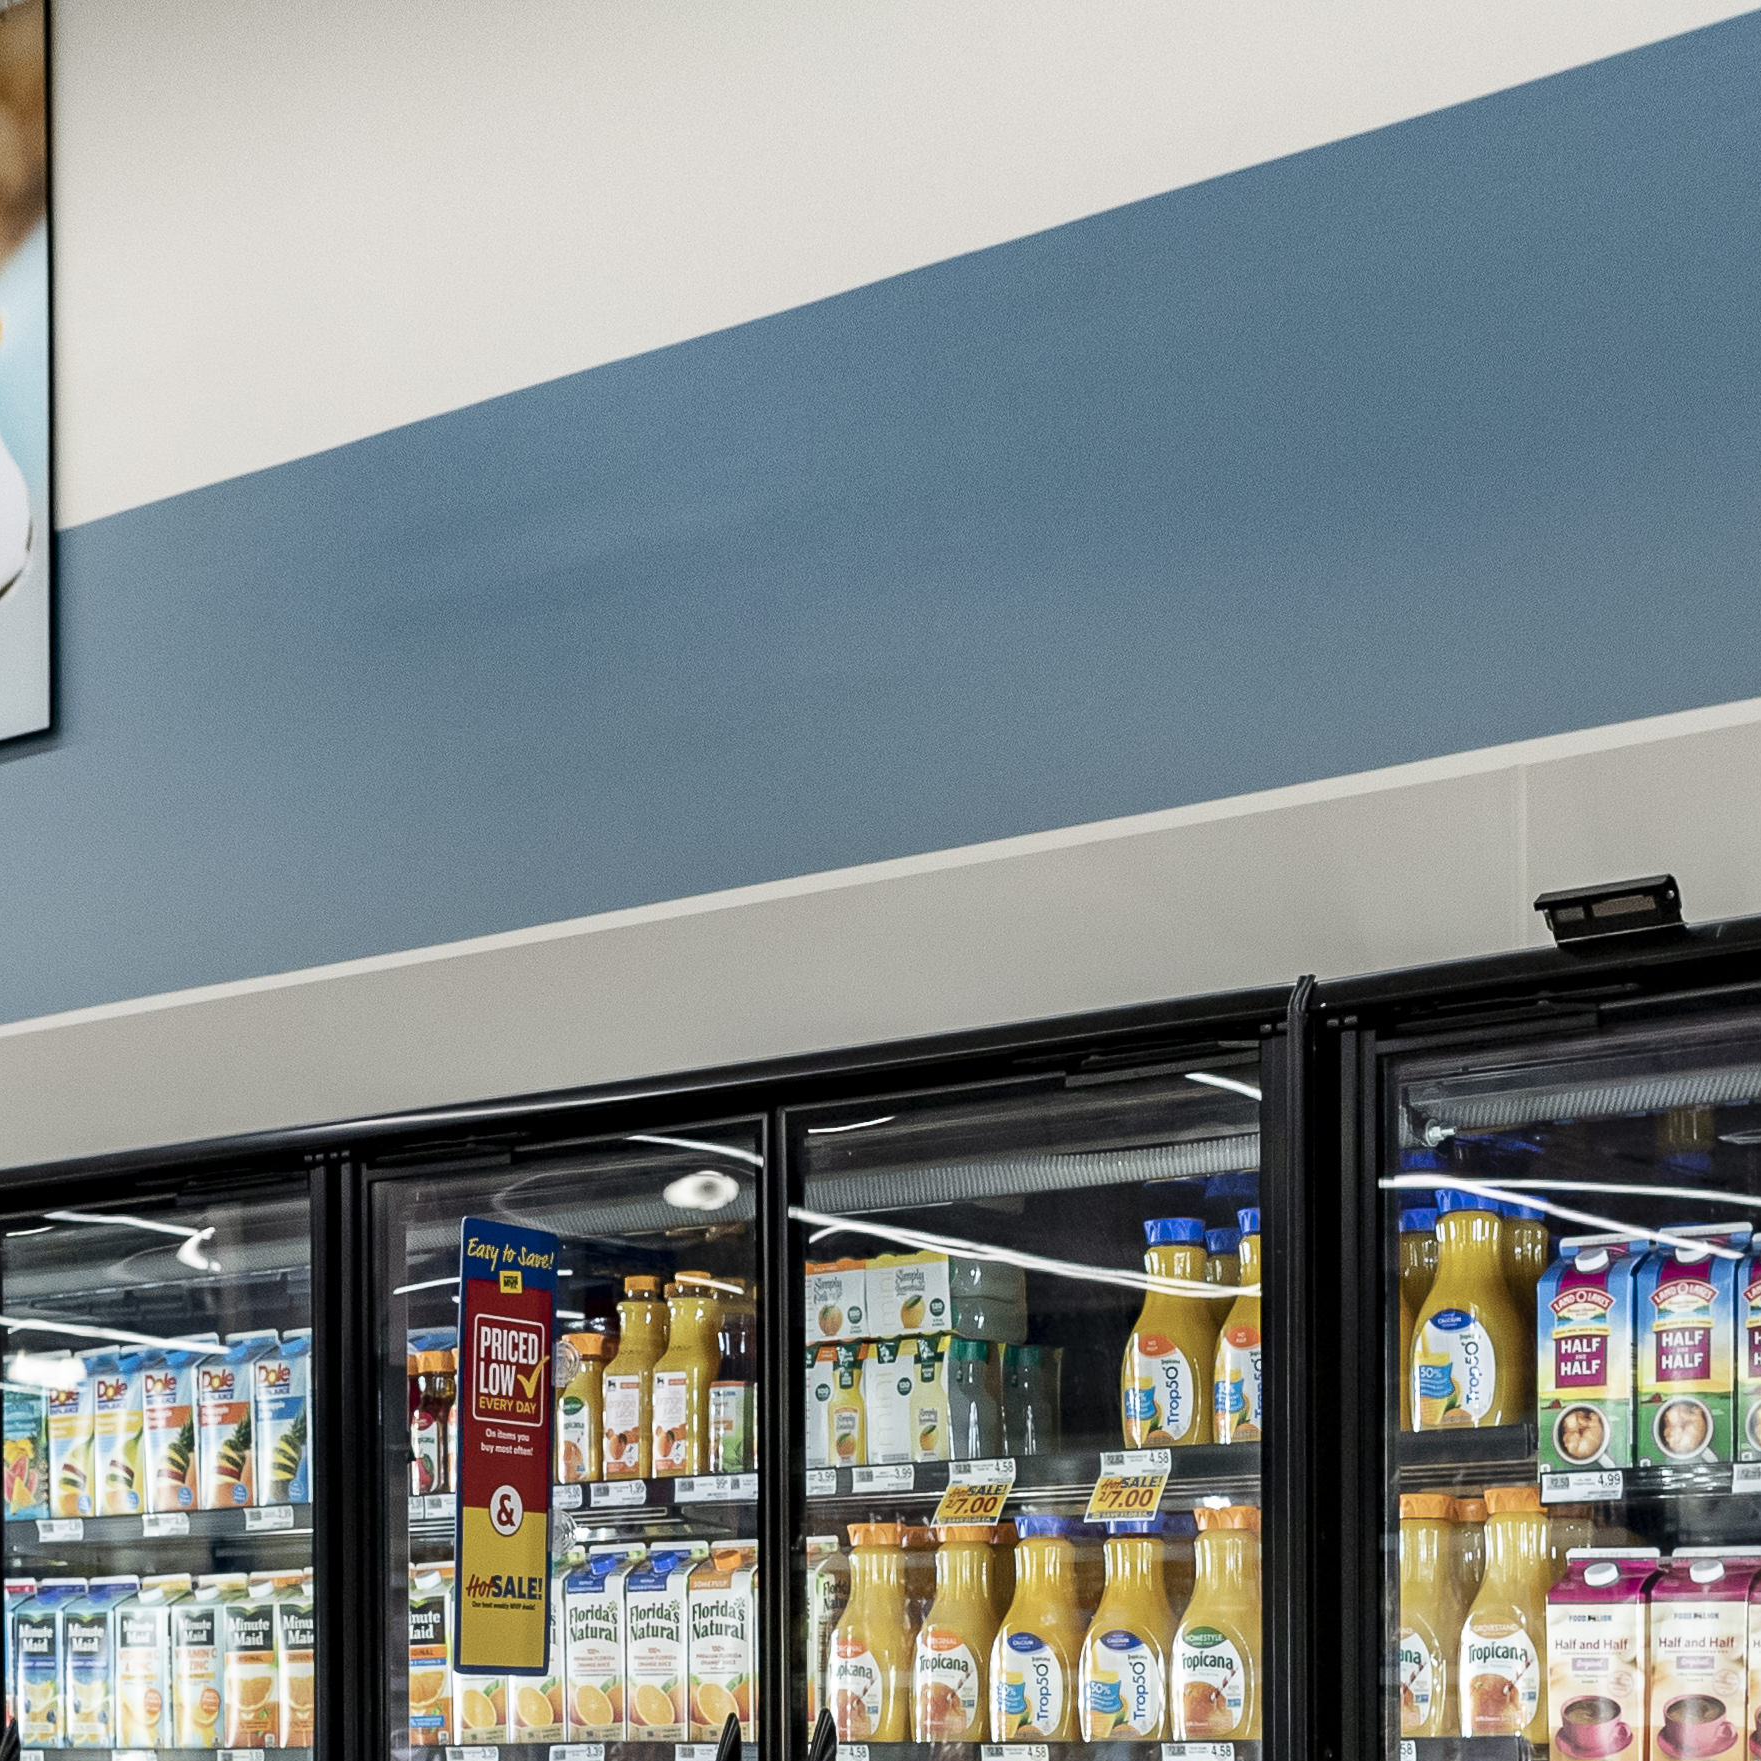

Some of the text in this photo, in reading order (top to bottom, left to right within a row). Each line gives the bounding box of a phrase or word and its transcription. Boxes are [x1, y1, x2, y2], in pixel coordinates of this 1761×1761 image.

[467, 1237, 554, 1271] Easy to Save!
[480, 1326, 538, 1365] PRICED
[1561, 1337, 1601, 1354] HALF
[257, 1363, 291, 1386] Dole
[480, 1361, 516, 1396] LOW
[1561, 1359, 1601, 1376] HALF
[144, 1373, 177, 1395] Dole
[201, 1369, 235, 1391] Dole
[479, 1397, 536, 1414] EVERY DAY
[486, 1428, 530, 1442] On items you
[481, 1442, 533, 1456] buy most often!
[1148, 1450, 1170, 1464] 4.58
[1598, 1473, 1621, 1488] 4.99
[497, 1494, 515, 1526] &
[569, 1601, 619, 1625] Florida's
[630, 1601, 680, 1624] Florida's
[228, 1617, 270, 1634] Minute
[569, 1619, 618, 1644] Natural
[630, 1618, 681, 1642] Natural
[233, 1631, 264, 1648] Maid
[1658, 1635, 1735, 1648] Half and Half
[1180, 1651, 1234, 1673] Tropicana
[1468, 1638, 1528, 1667] Tropicana
